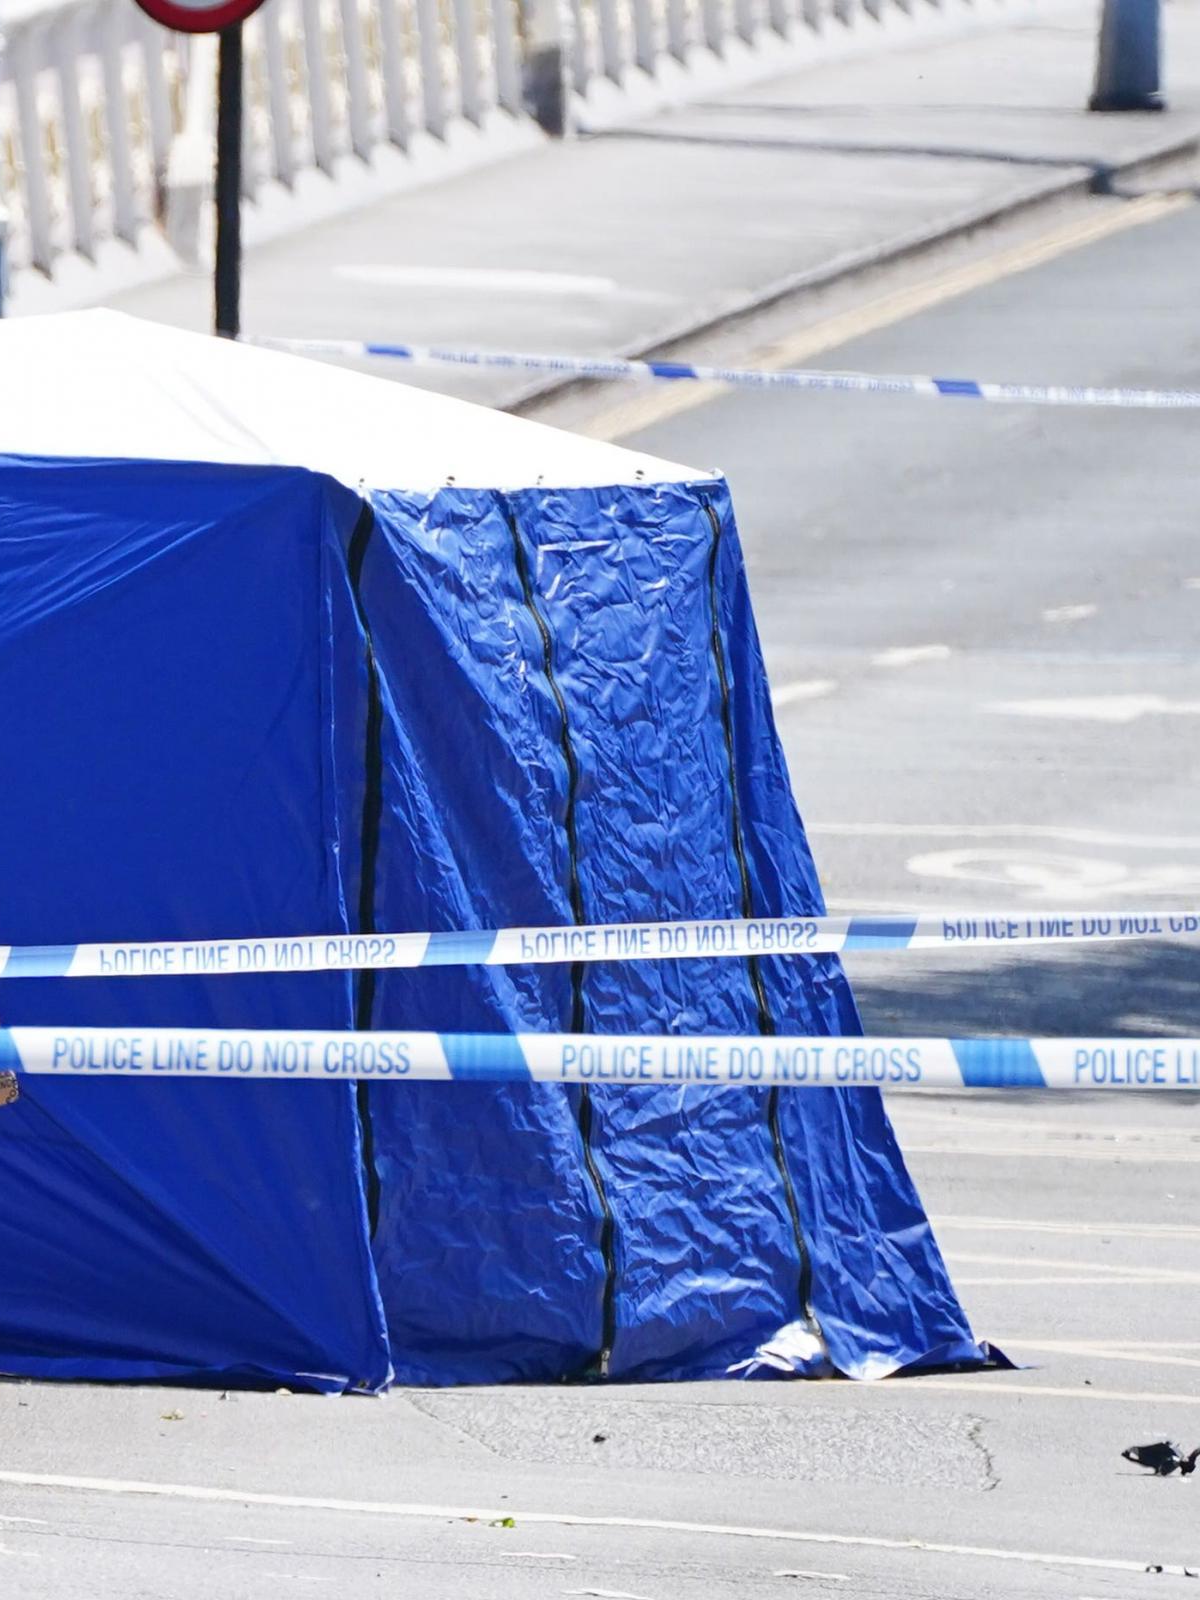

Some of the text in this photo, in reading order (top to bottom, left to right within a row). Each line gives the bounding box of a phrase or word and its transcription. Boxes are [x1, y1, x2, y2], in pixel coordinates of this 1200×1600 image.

[52, 1036, 411, 1075] POLICE LINE DO NOT CROSS
[560, 1044, 922, 1082] POLICE LINE DO NOT CROSS
[1073, 1048, 1199, 1084] POLICE LI
